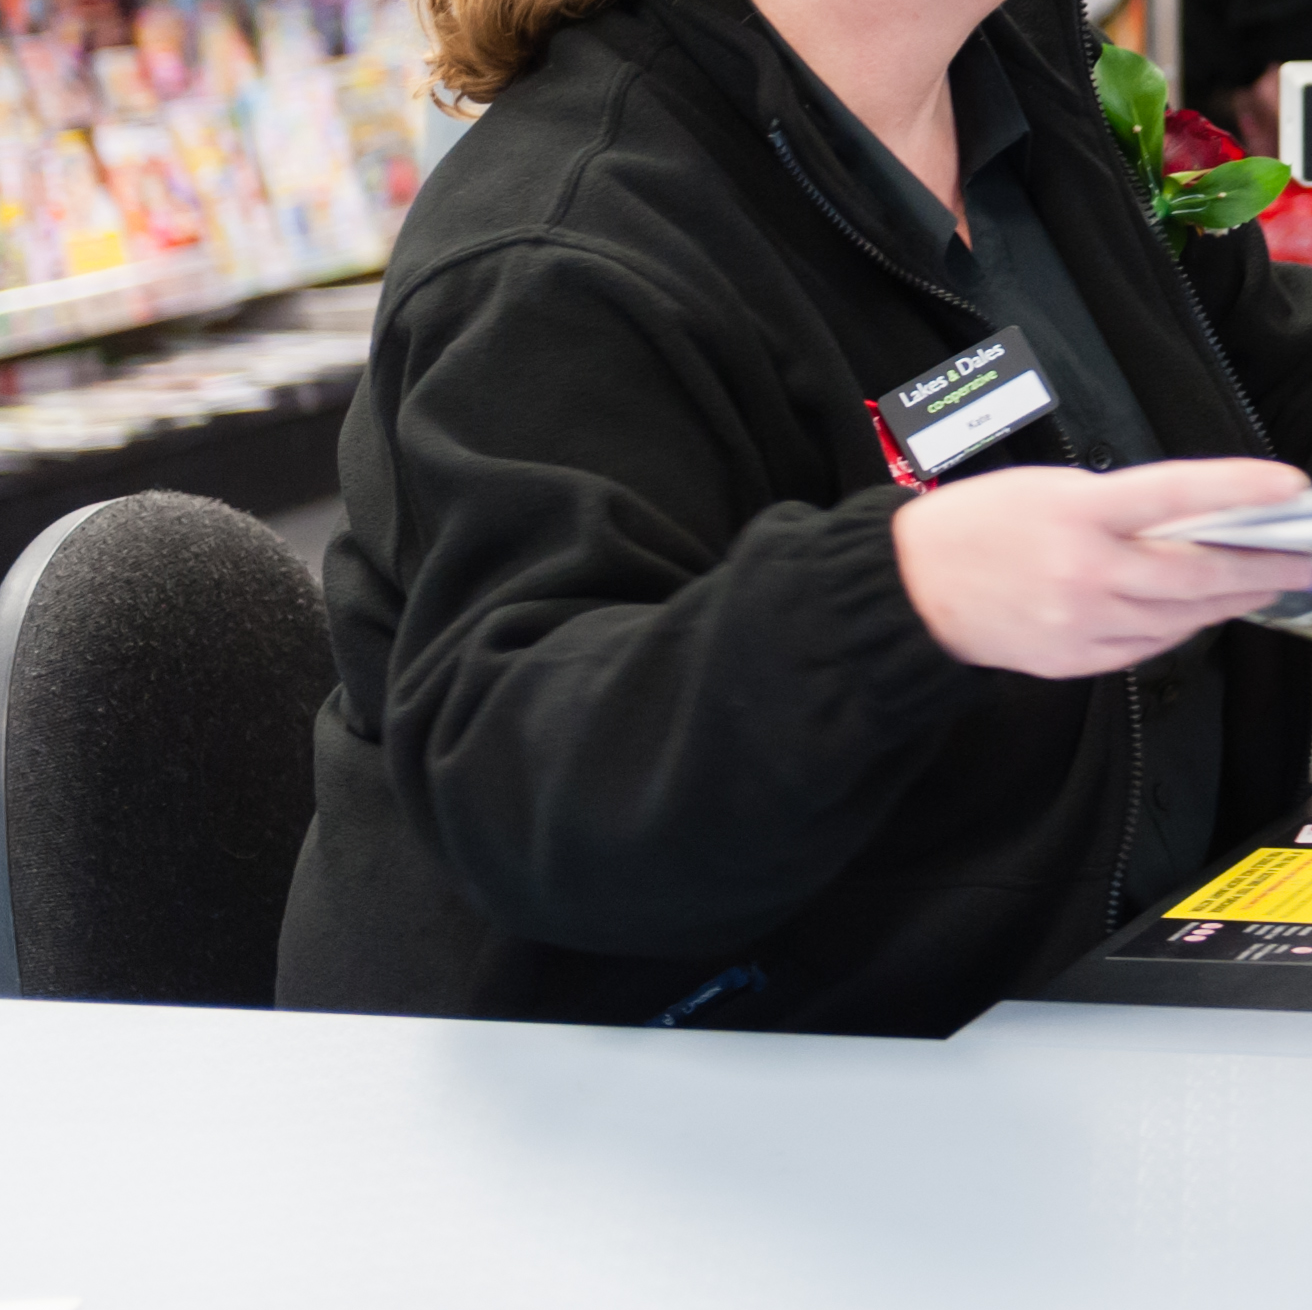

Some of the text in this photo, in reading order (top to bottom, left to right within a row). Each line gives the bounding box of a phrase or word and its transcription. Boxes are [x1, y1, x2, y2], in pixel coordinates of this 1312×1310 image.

[898, 374, 949, 408] Lakes
[954, 343, 1006, 376] Dales
[927, 369, 999, 414] co-operative
